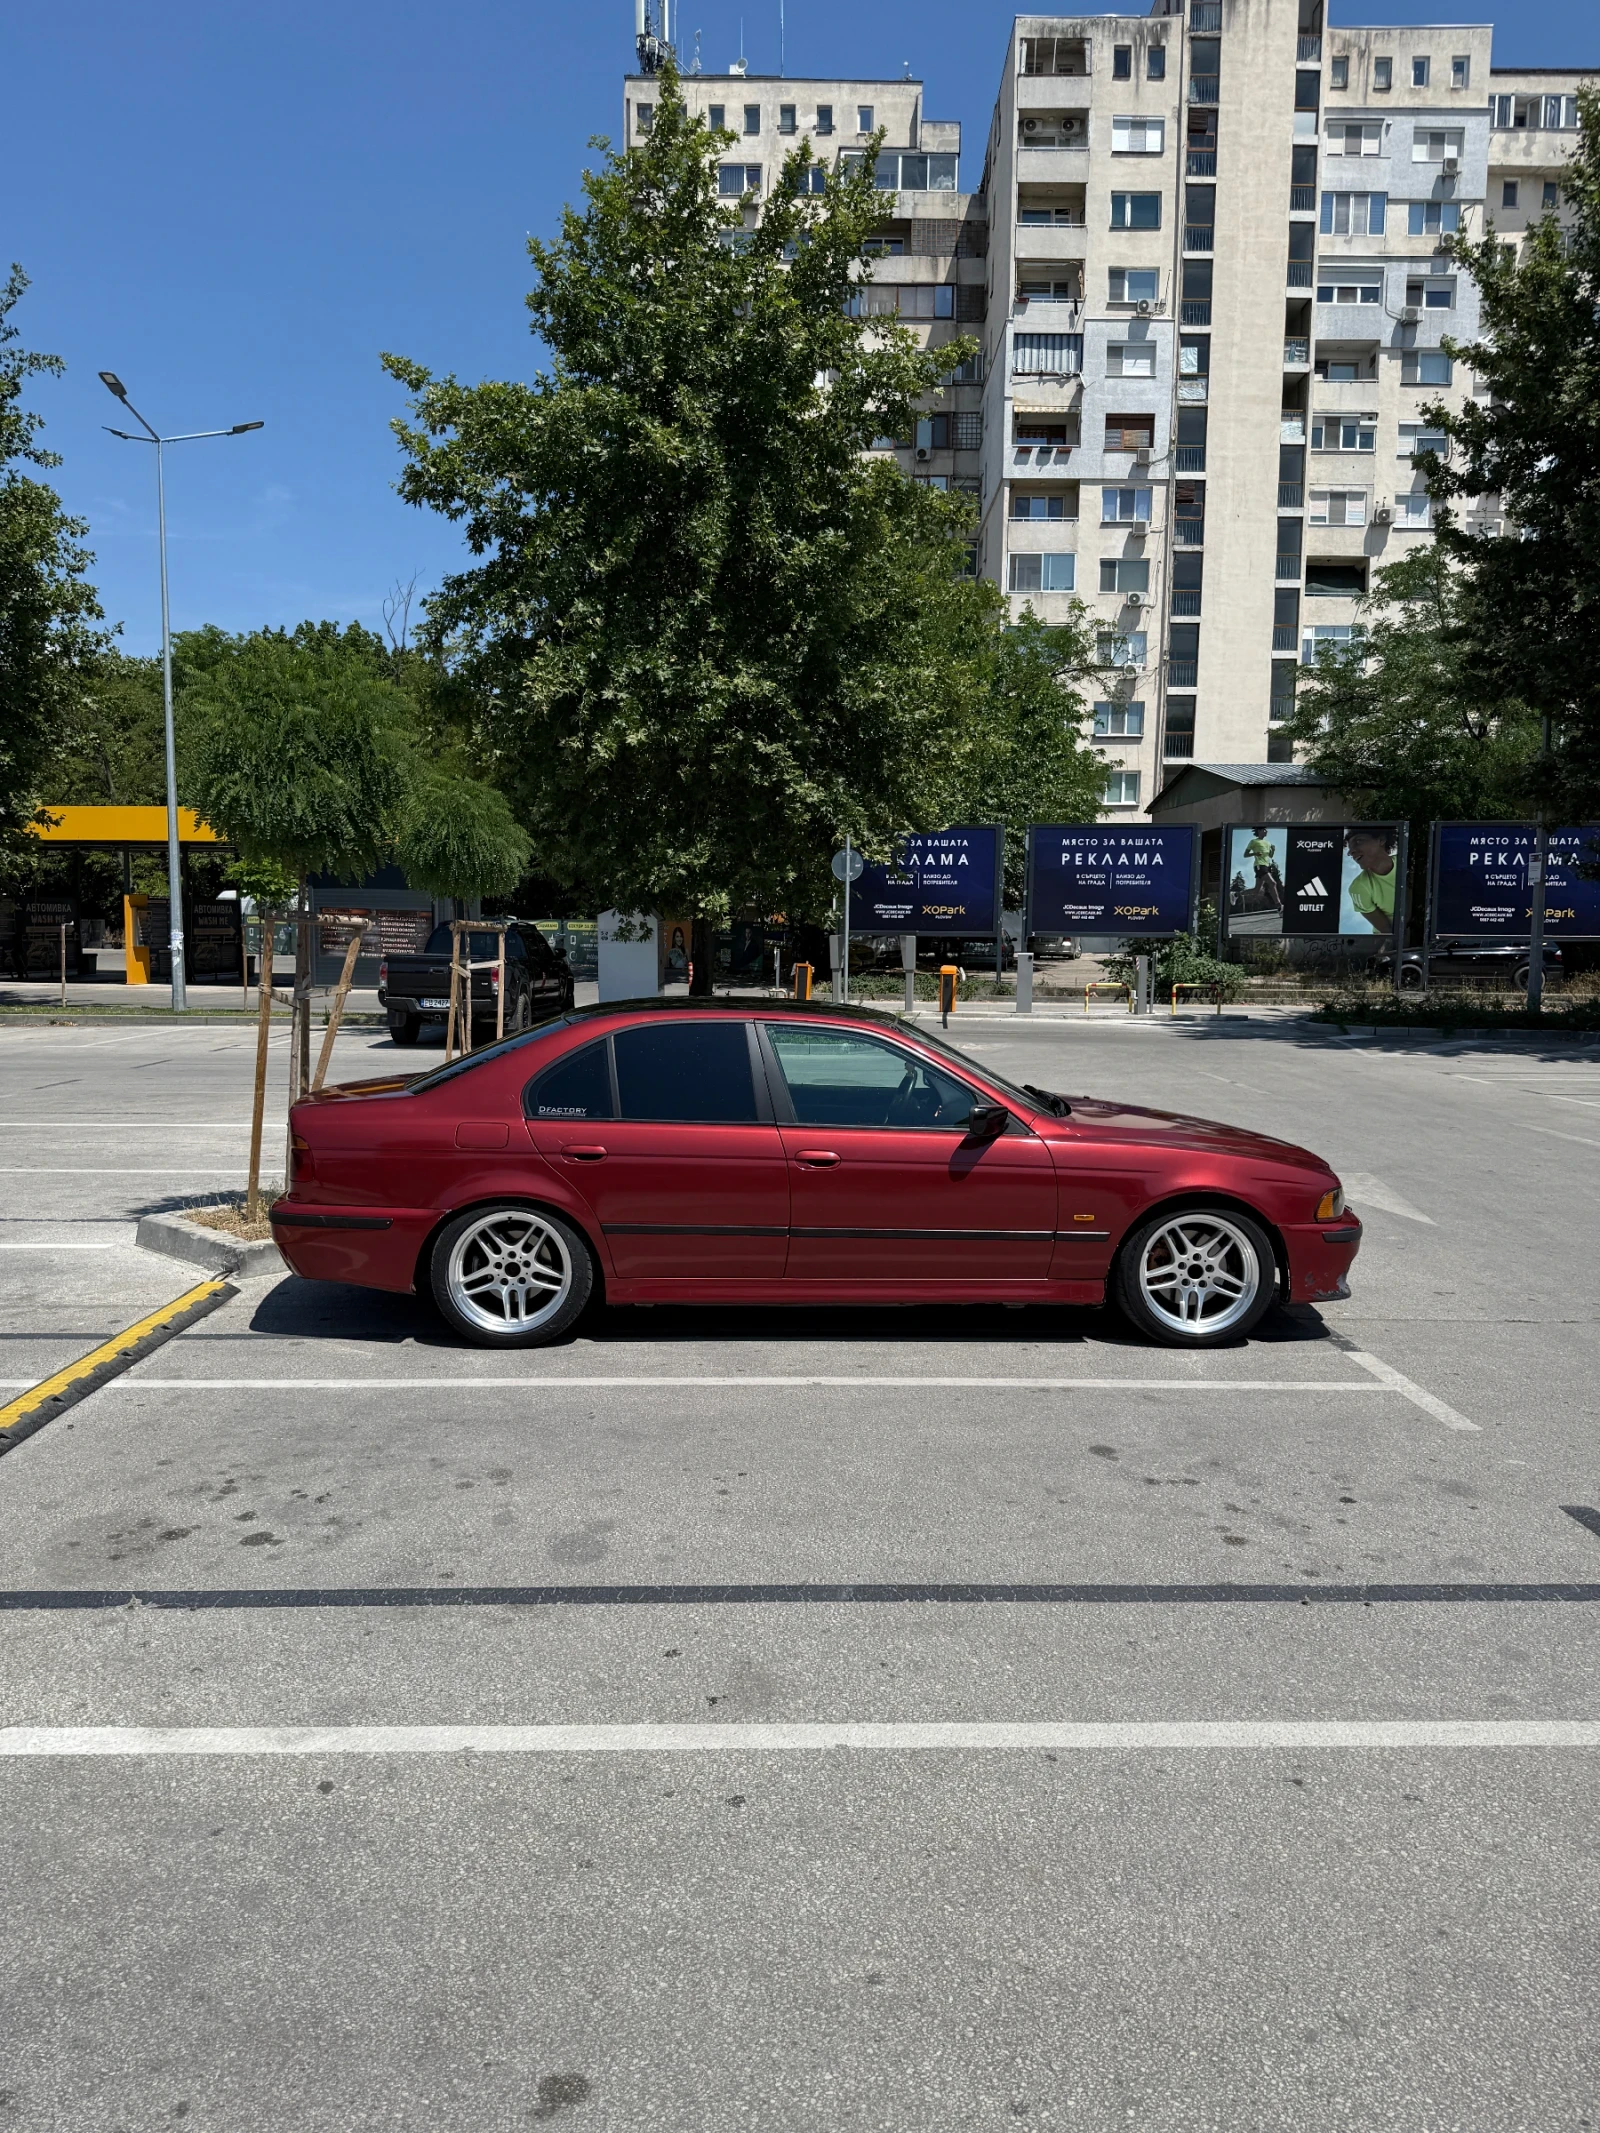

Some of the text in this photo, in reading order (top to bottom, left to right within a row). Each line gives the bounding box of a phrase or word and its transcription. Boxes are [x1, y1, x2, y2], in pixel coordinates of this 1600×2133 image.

[1061, 853, 1164, 865] РЕКЛАМА
[1469, 853, 1580, 865] РЕКЛМА
[25, 903, 72, 912] АВТОМИВКА
[194, 905, 233, 914] АВТОМИВКА
[922, 905, 966, 914] XOPark
[1114, 905, 1159, 915] XOPark
[1525, 908, 1575, 918] XPark
[31, 914, 54, 923] WASH
[198, 916, 229, 925] WASH ME
